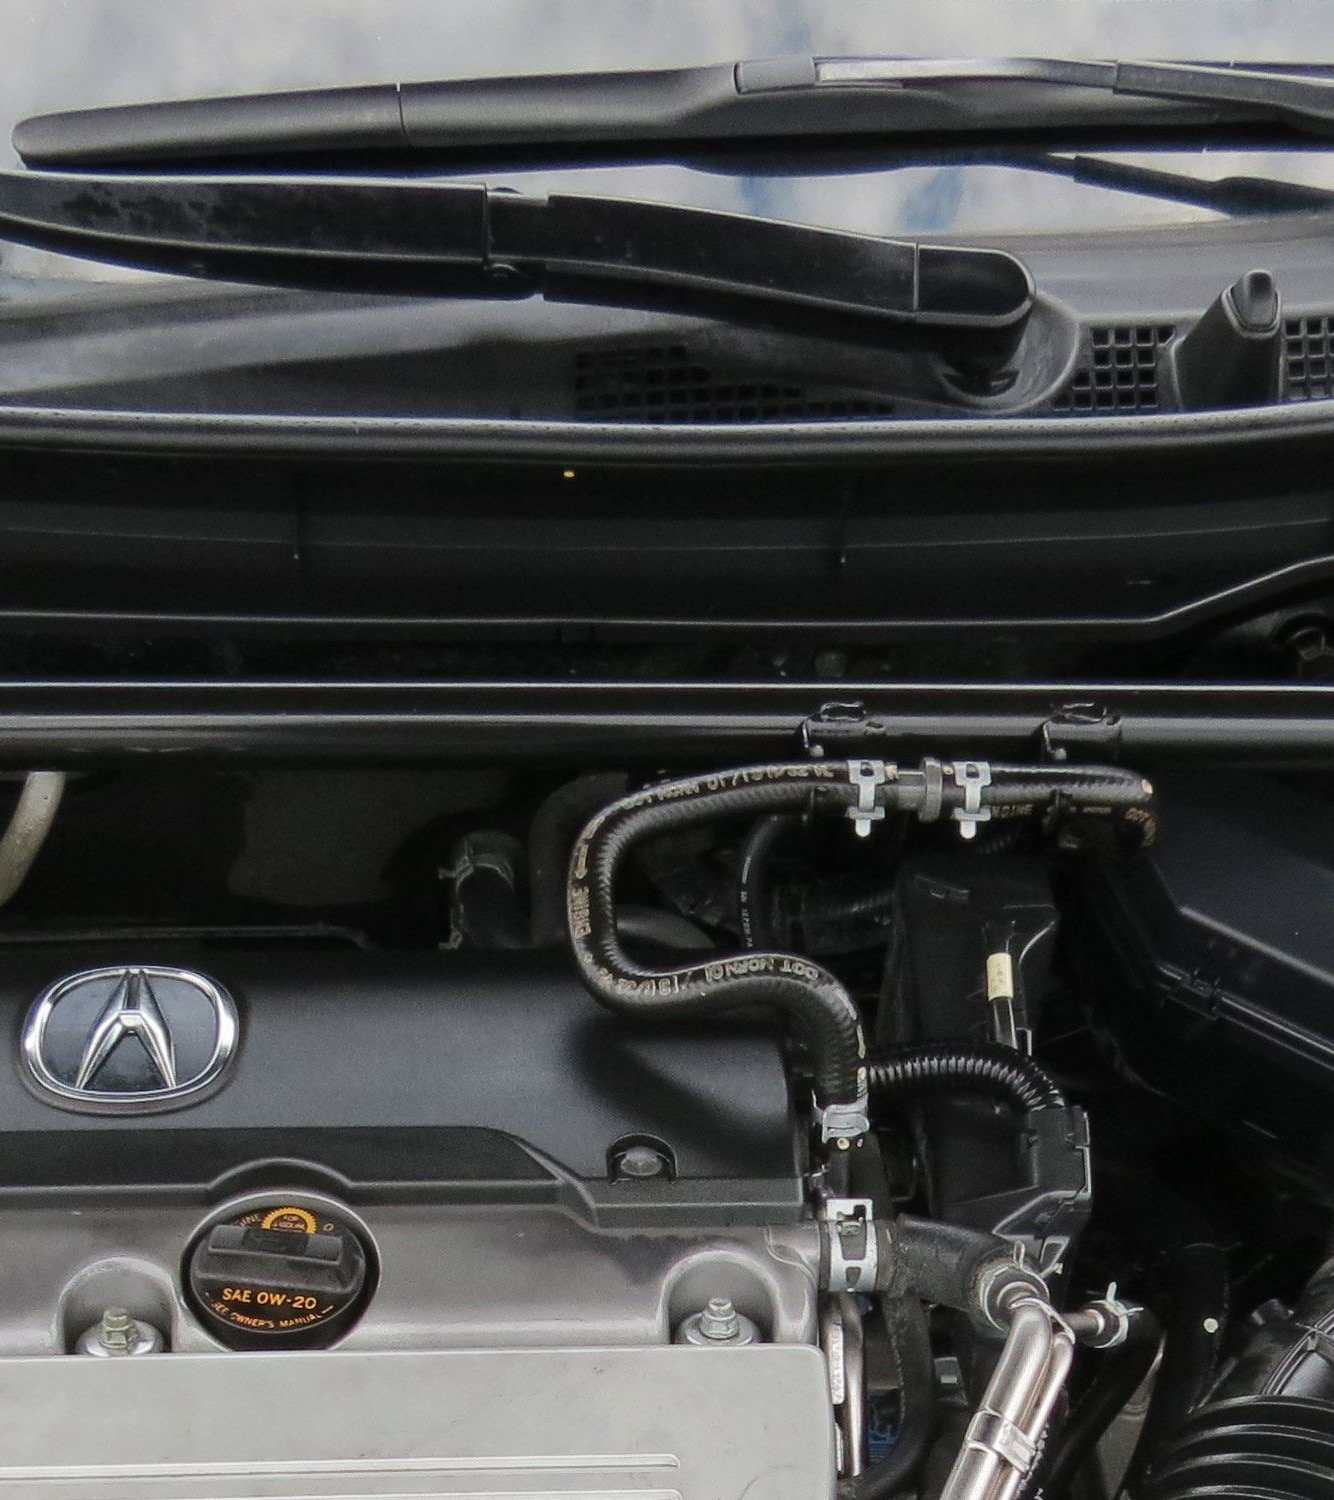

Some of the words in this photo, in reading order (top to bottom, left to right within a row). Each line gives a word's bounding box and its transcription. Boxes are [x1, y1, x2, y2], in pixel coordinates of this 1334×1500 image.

[222, 1287, 252, 1303] SAE
[256, 1291, 317, 1310] 0W-20
[279, 1313, 323, 1328] MANUAL
